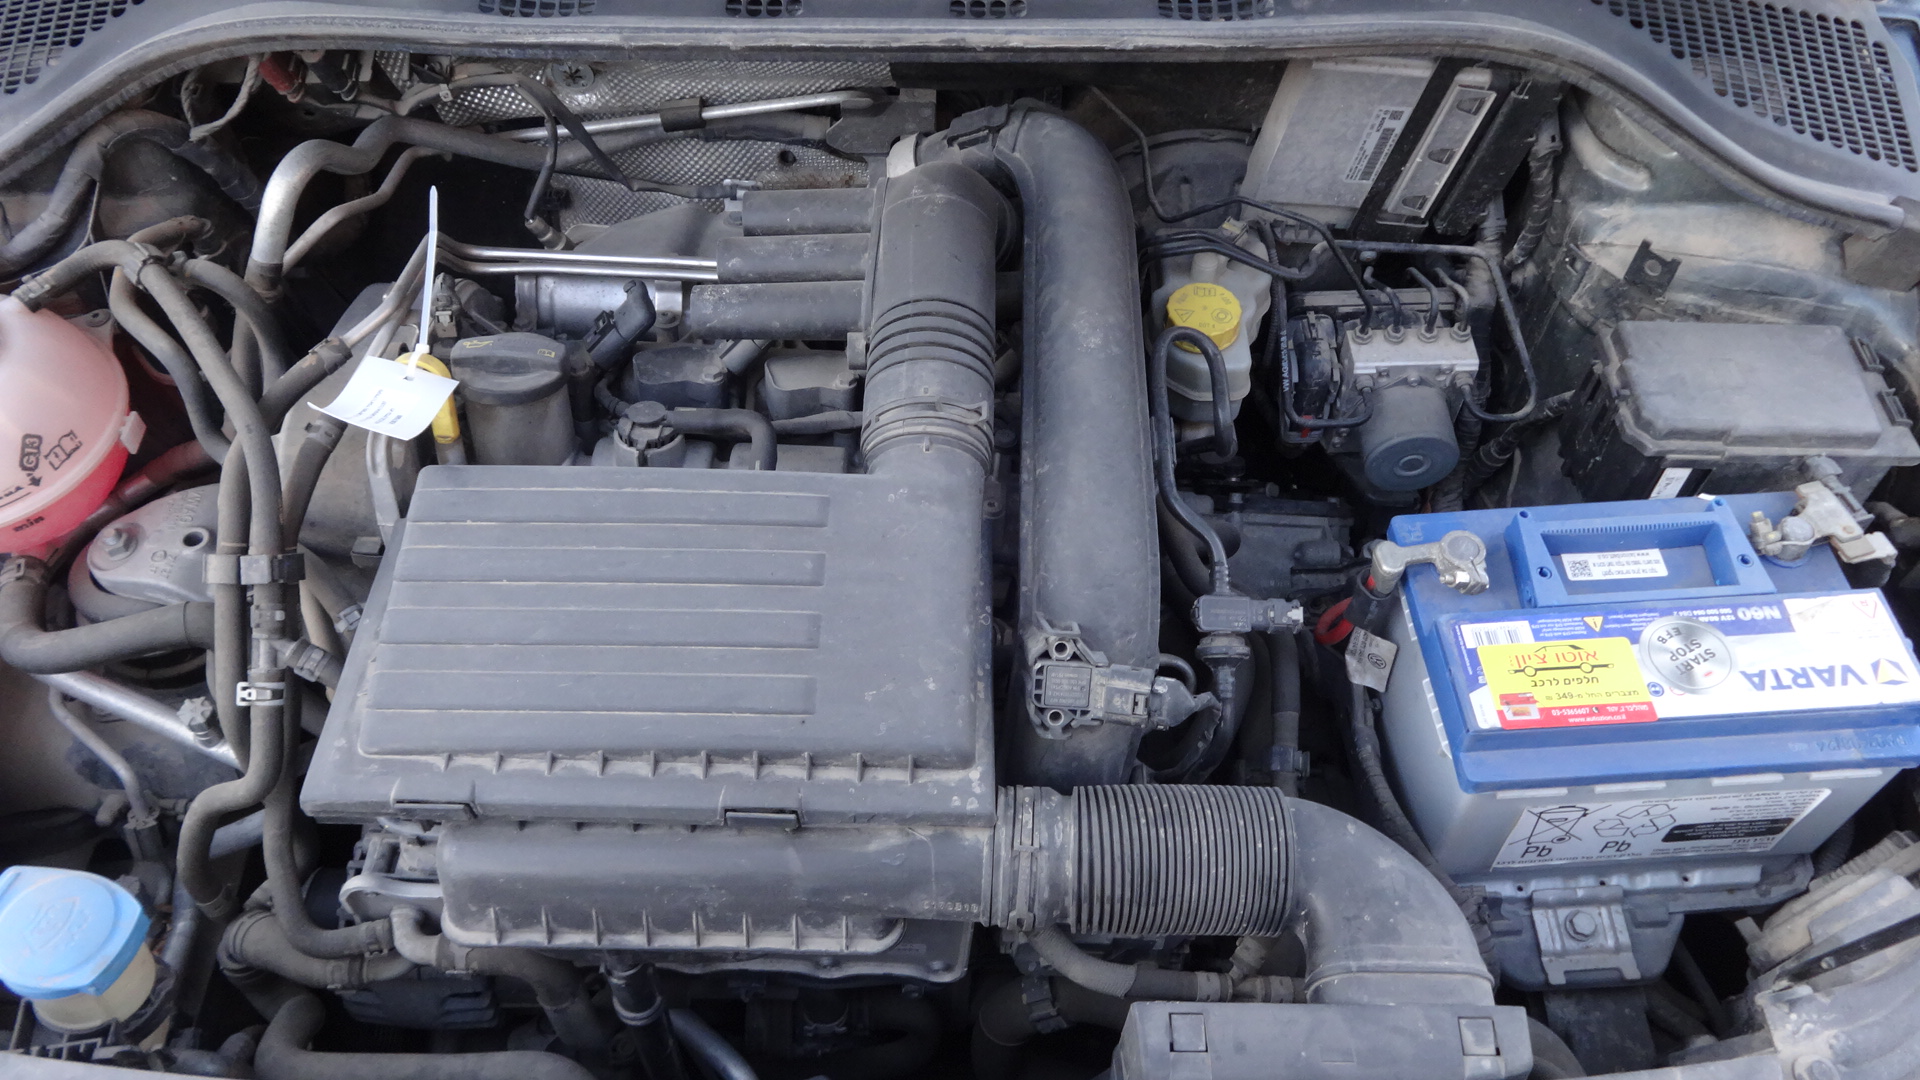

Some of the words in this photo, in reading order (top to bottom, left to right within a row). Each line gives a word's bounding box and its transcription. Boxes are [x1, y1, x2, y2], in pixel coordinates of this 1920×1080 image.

[23, 437, 39, 467] G13
[1738, 605, 1782, 622] N60
[1656, 626, 1682, 645] EFB
[1556, 650, 1600, 662] אוטו
[1668, 638, 1702, 662] STOP
[1514, 653, 1548, 668] ציון
[1675, 648, 1716, 675] START
[1531, 678, 1560, 688] לרכב
[1564, 676, 1600, 686] חלפים
[1739, 665, 1867, 692] VARTA
[1552, 707, 1590, 716] 03-5365607
[1520, 841, 1553, 859] Pb
[1599, 836, 1634, 854] Pb
